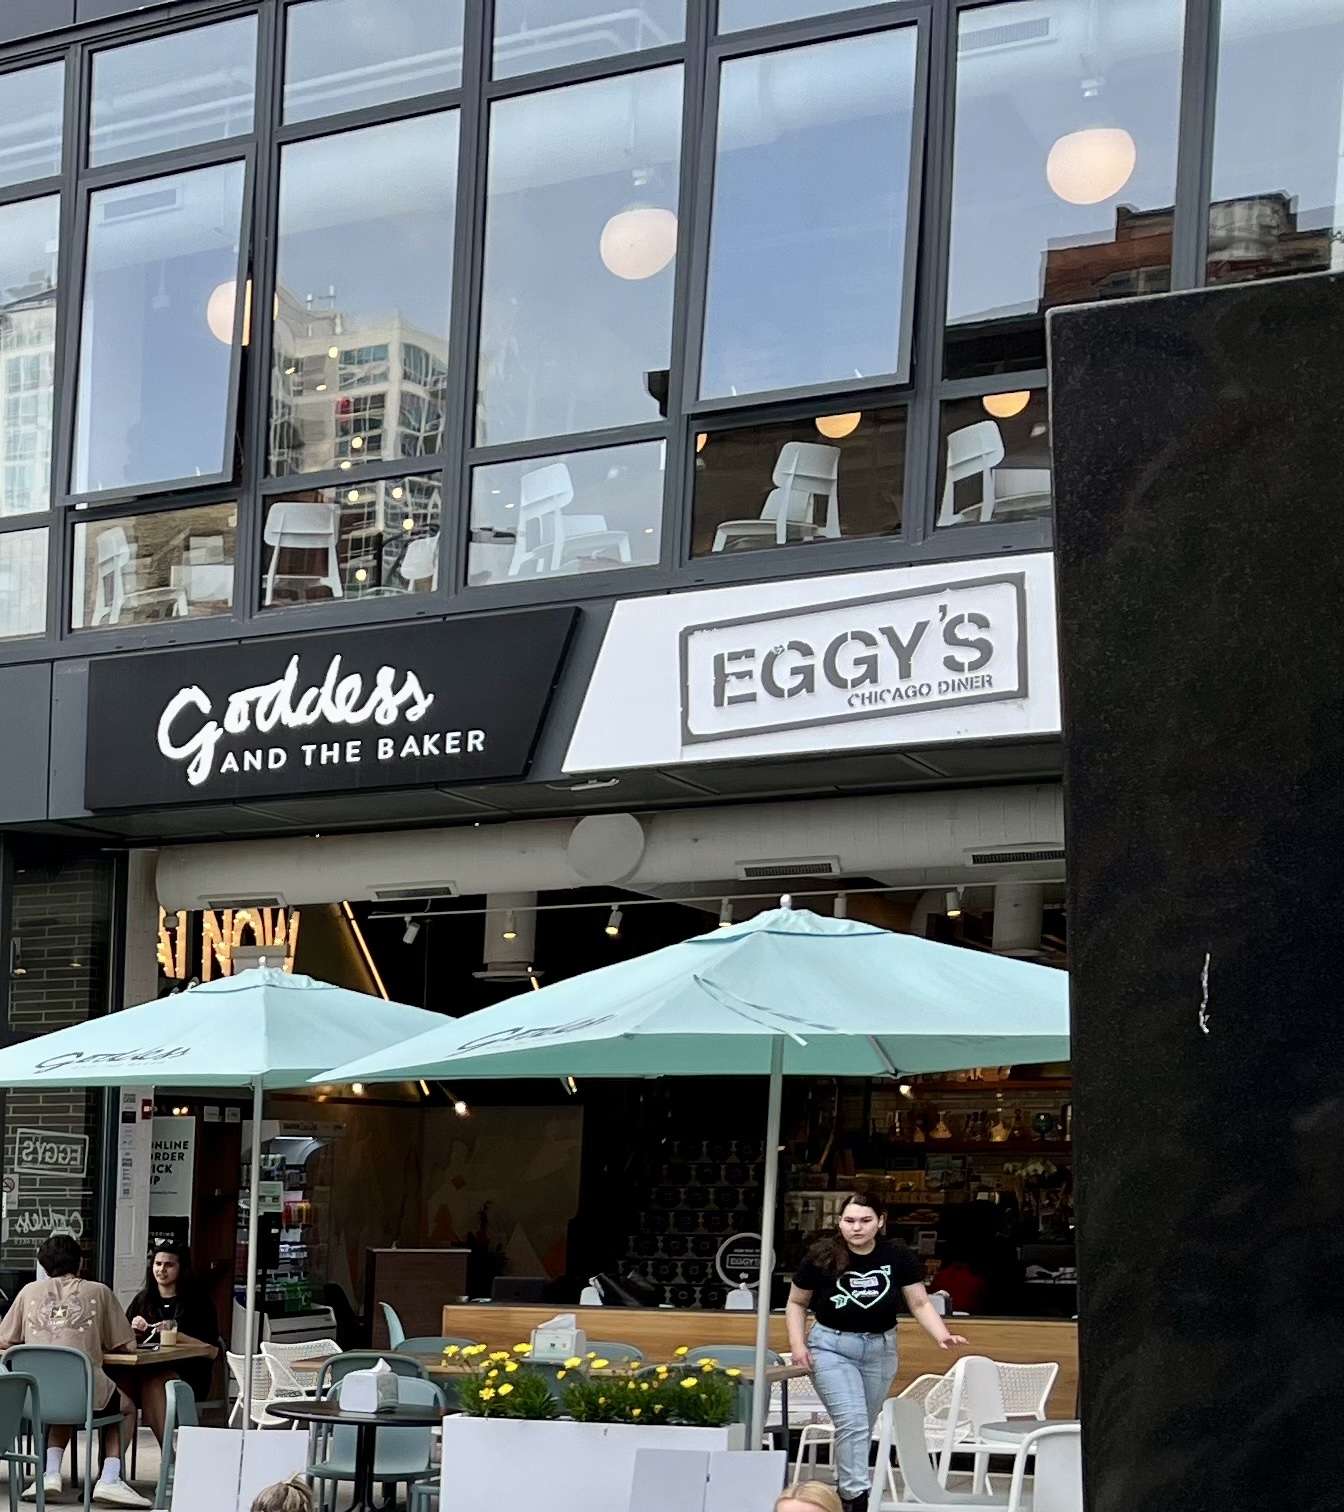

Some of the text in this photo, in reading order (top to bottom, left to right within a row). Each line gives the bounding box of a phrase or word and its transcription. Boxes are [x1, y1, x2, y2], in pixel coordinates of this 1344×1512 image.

[712, 603, 994, 708] EGGY'S
[846, 673, 993, 708] CHICAGO DINER
[156, 653, 435, 787] Goddess
[219, 729, 487, 774] AND THE BAKER
[150, 1152, 185, 1162] RDER
[151, 1140, 189, 1151] NLINE
[150, 1163, 173, 1174] ICK
